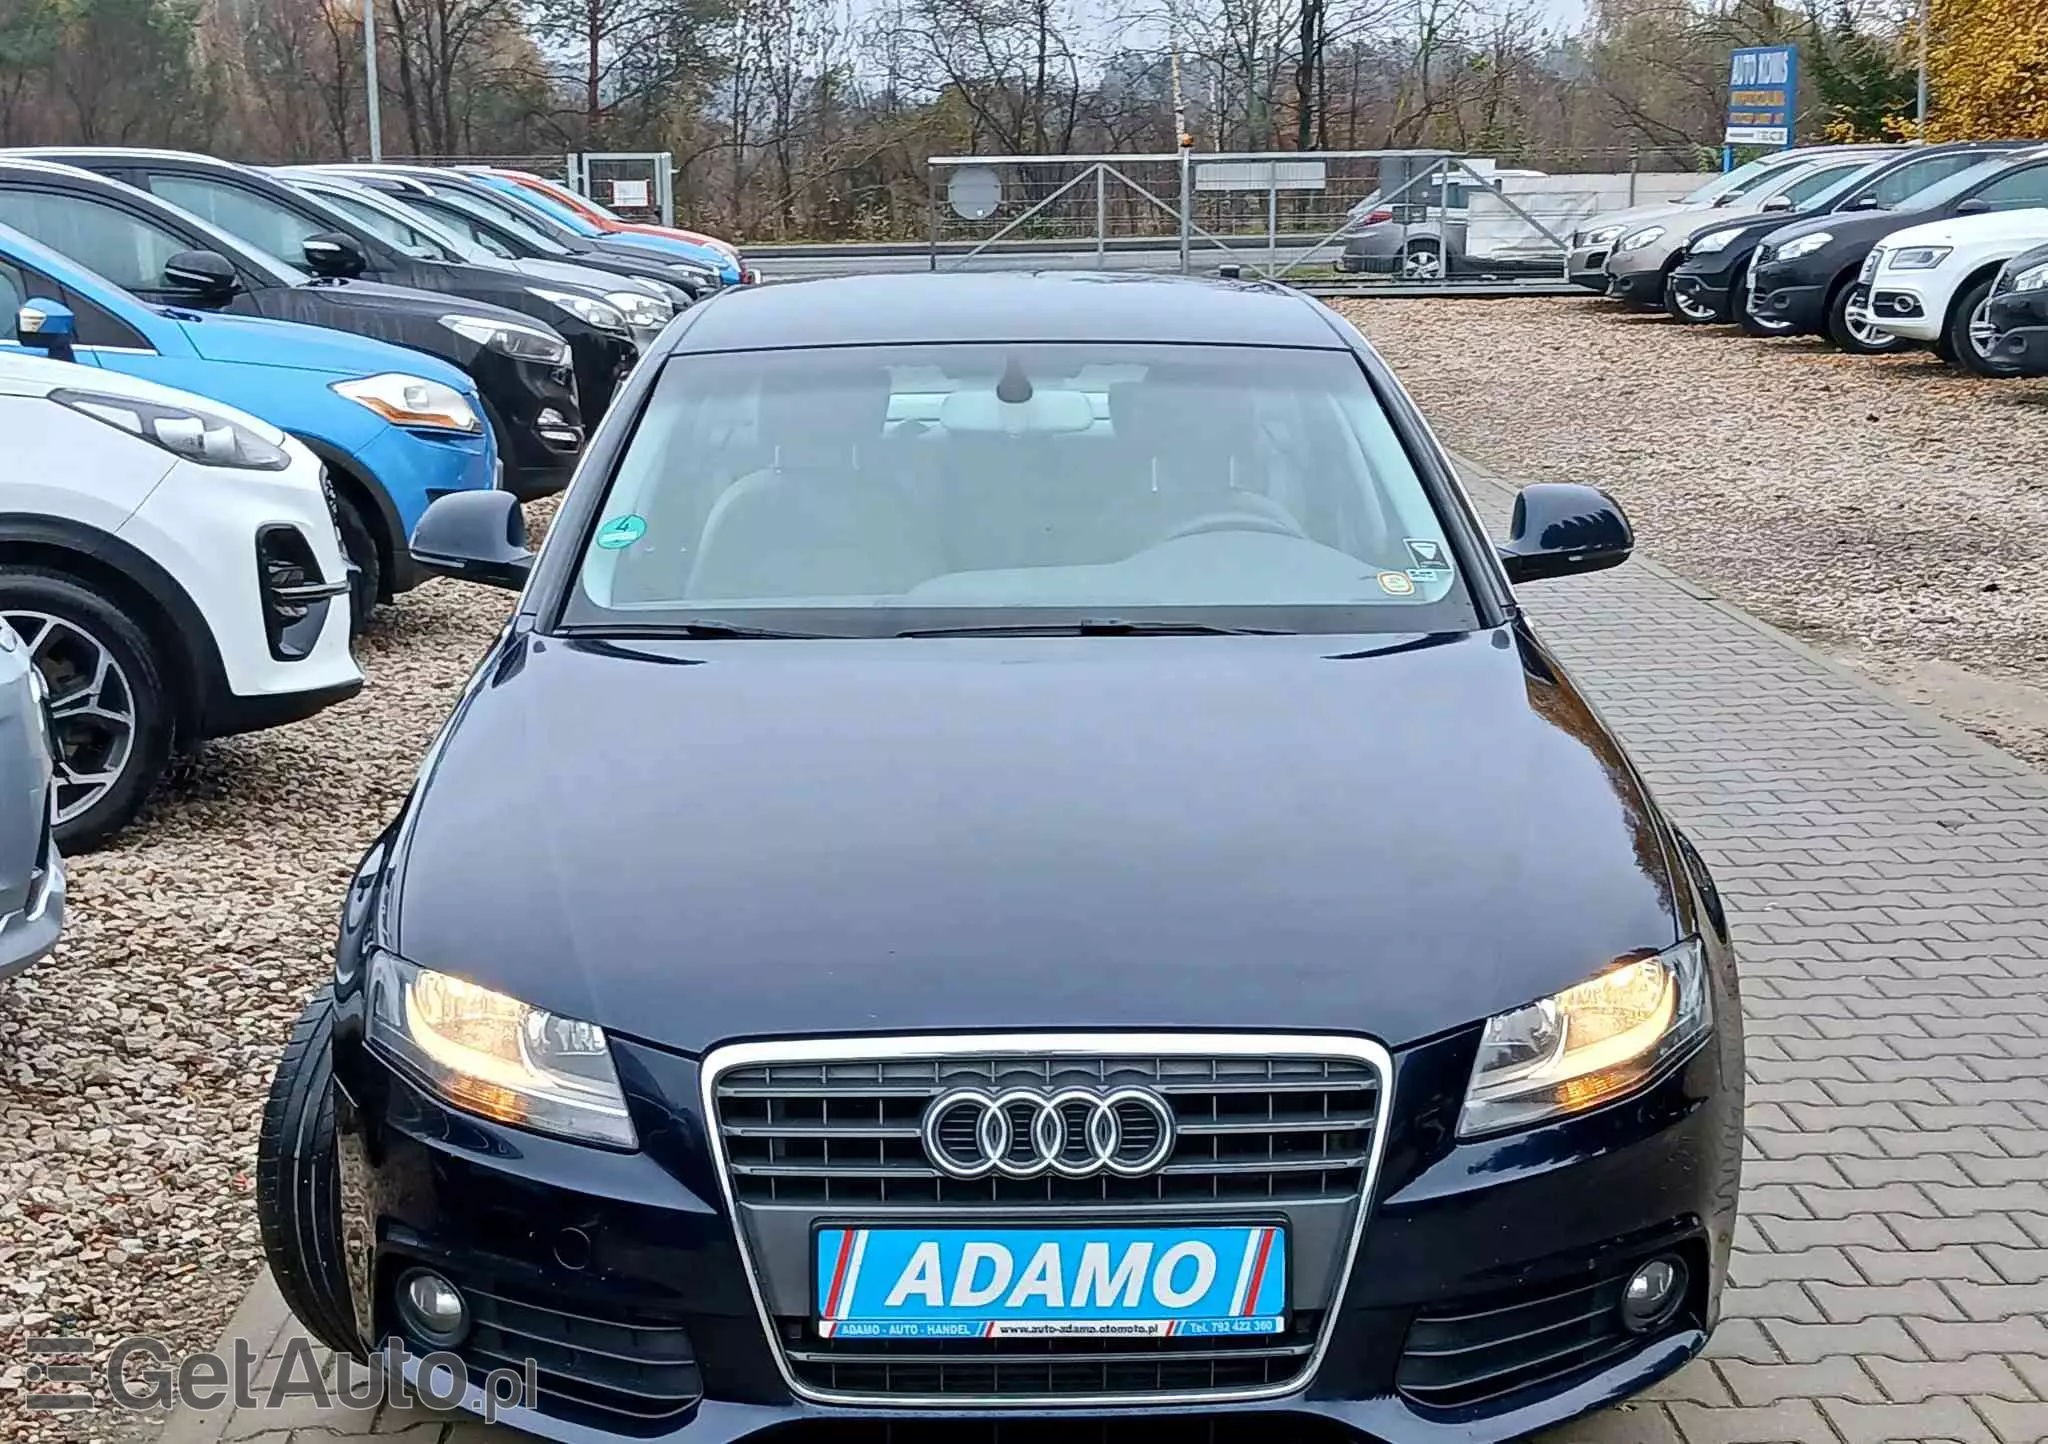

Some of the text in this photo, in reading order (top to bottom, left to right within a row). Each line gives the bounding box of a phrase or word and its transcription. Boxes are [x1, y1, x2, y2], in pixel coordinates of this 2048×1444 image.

[884, 1240, 1217, 1308] ADAMO
[841, 1324, 880, 1335] ADAMO
[889, 1324, 918, 1335] AUTO
[927, 1324, 971, 1335] HANDEL
[1000, 1323, 1159, 1336] www.auto-adamo.otomoto.pl
